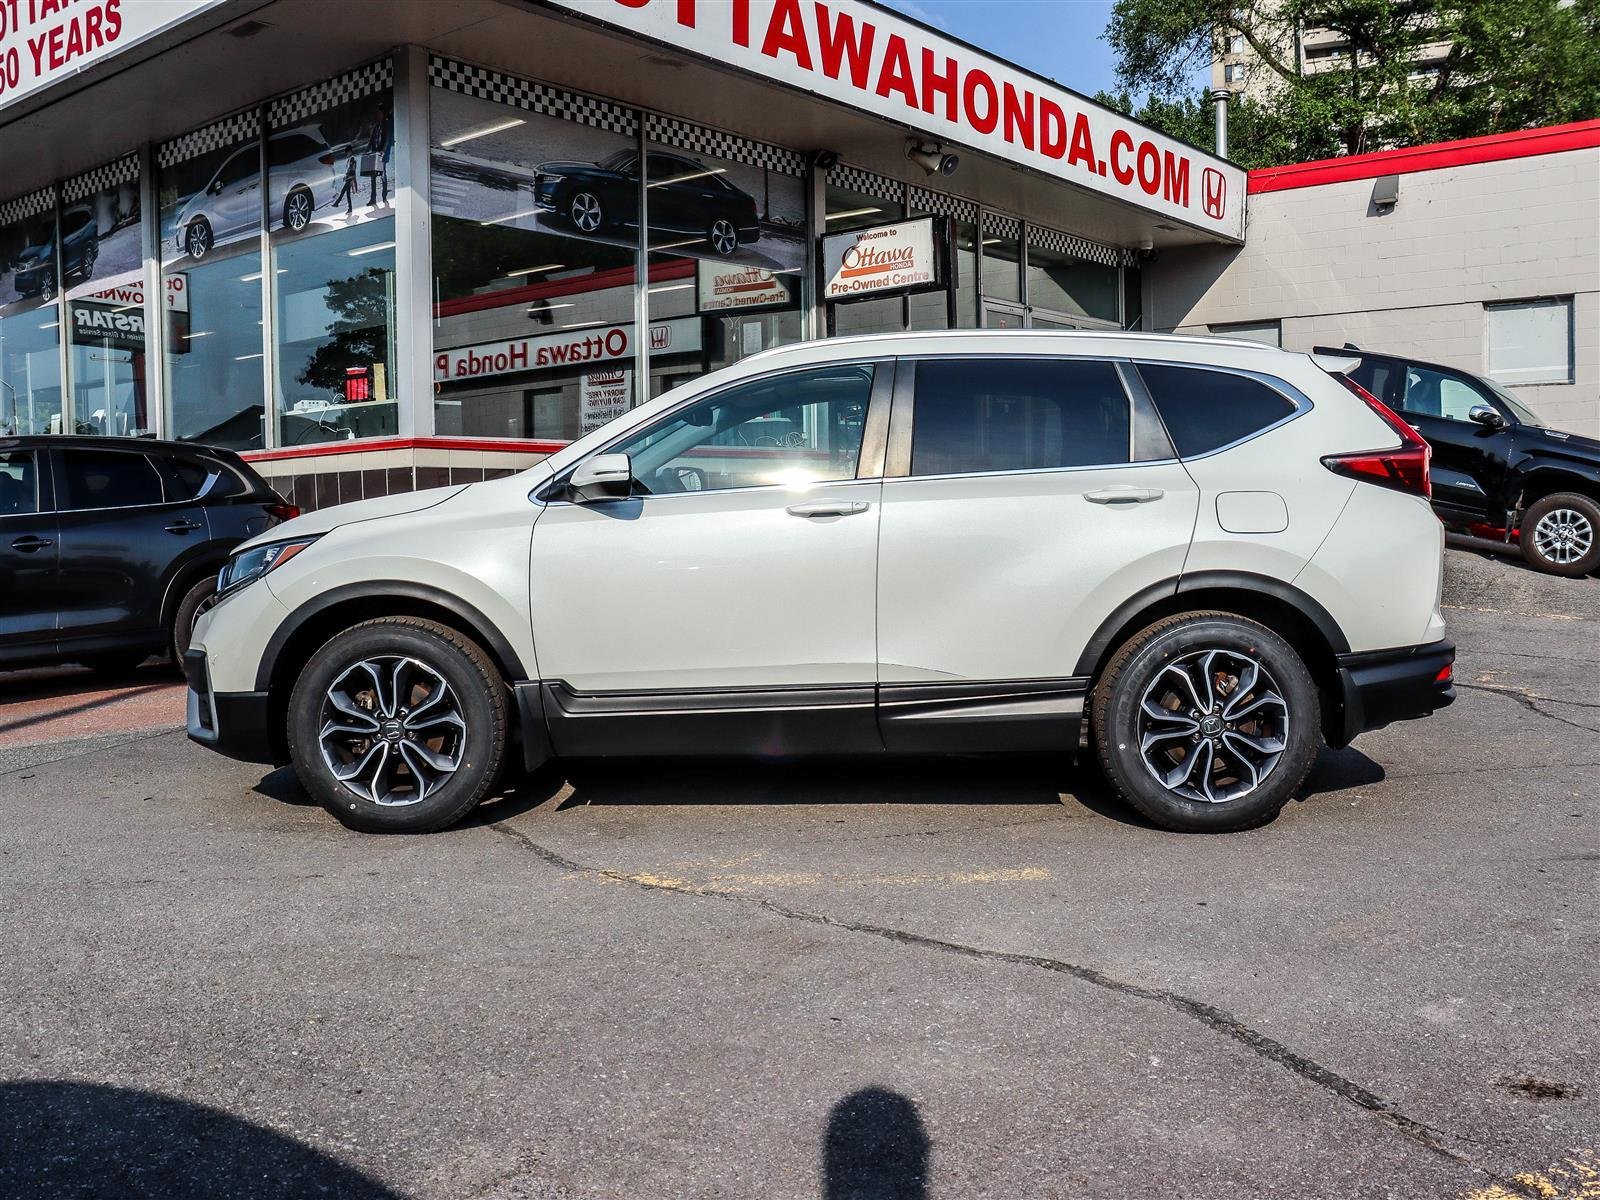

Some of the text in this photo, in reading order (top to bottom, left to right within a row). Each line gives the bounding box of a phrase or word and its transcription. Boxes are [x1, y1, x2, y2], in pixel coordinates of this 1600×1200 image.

[27, 0, 122, 77] YEARS
[856, 231, 888, 242] Welcome
[842, 245, 914, 269] Ottawa
[890, 262, 912, 270] HONDA
[831, 271, 929, 294] Pre-Owned Centre
